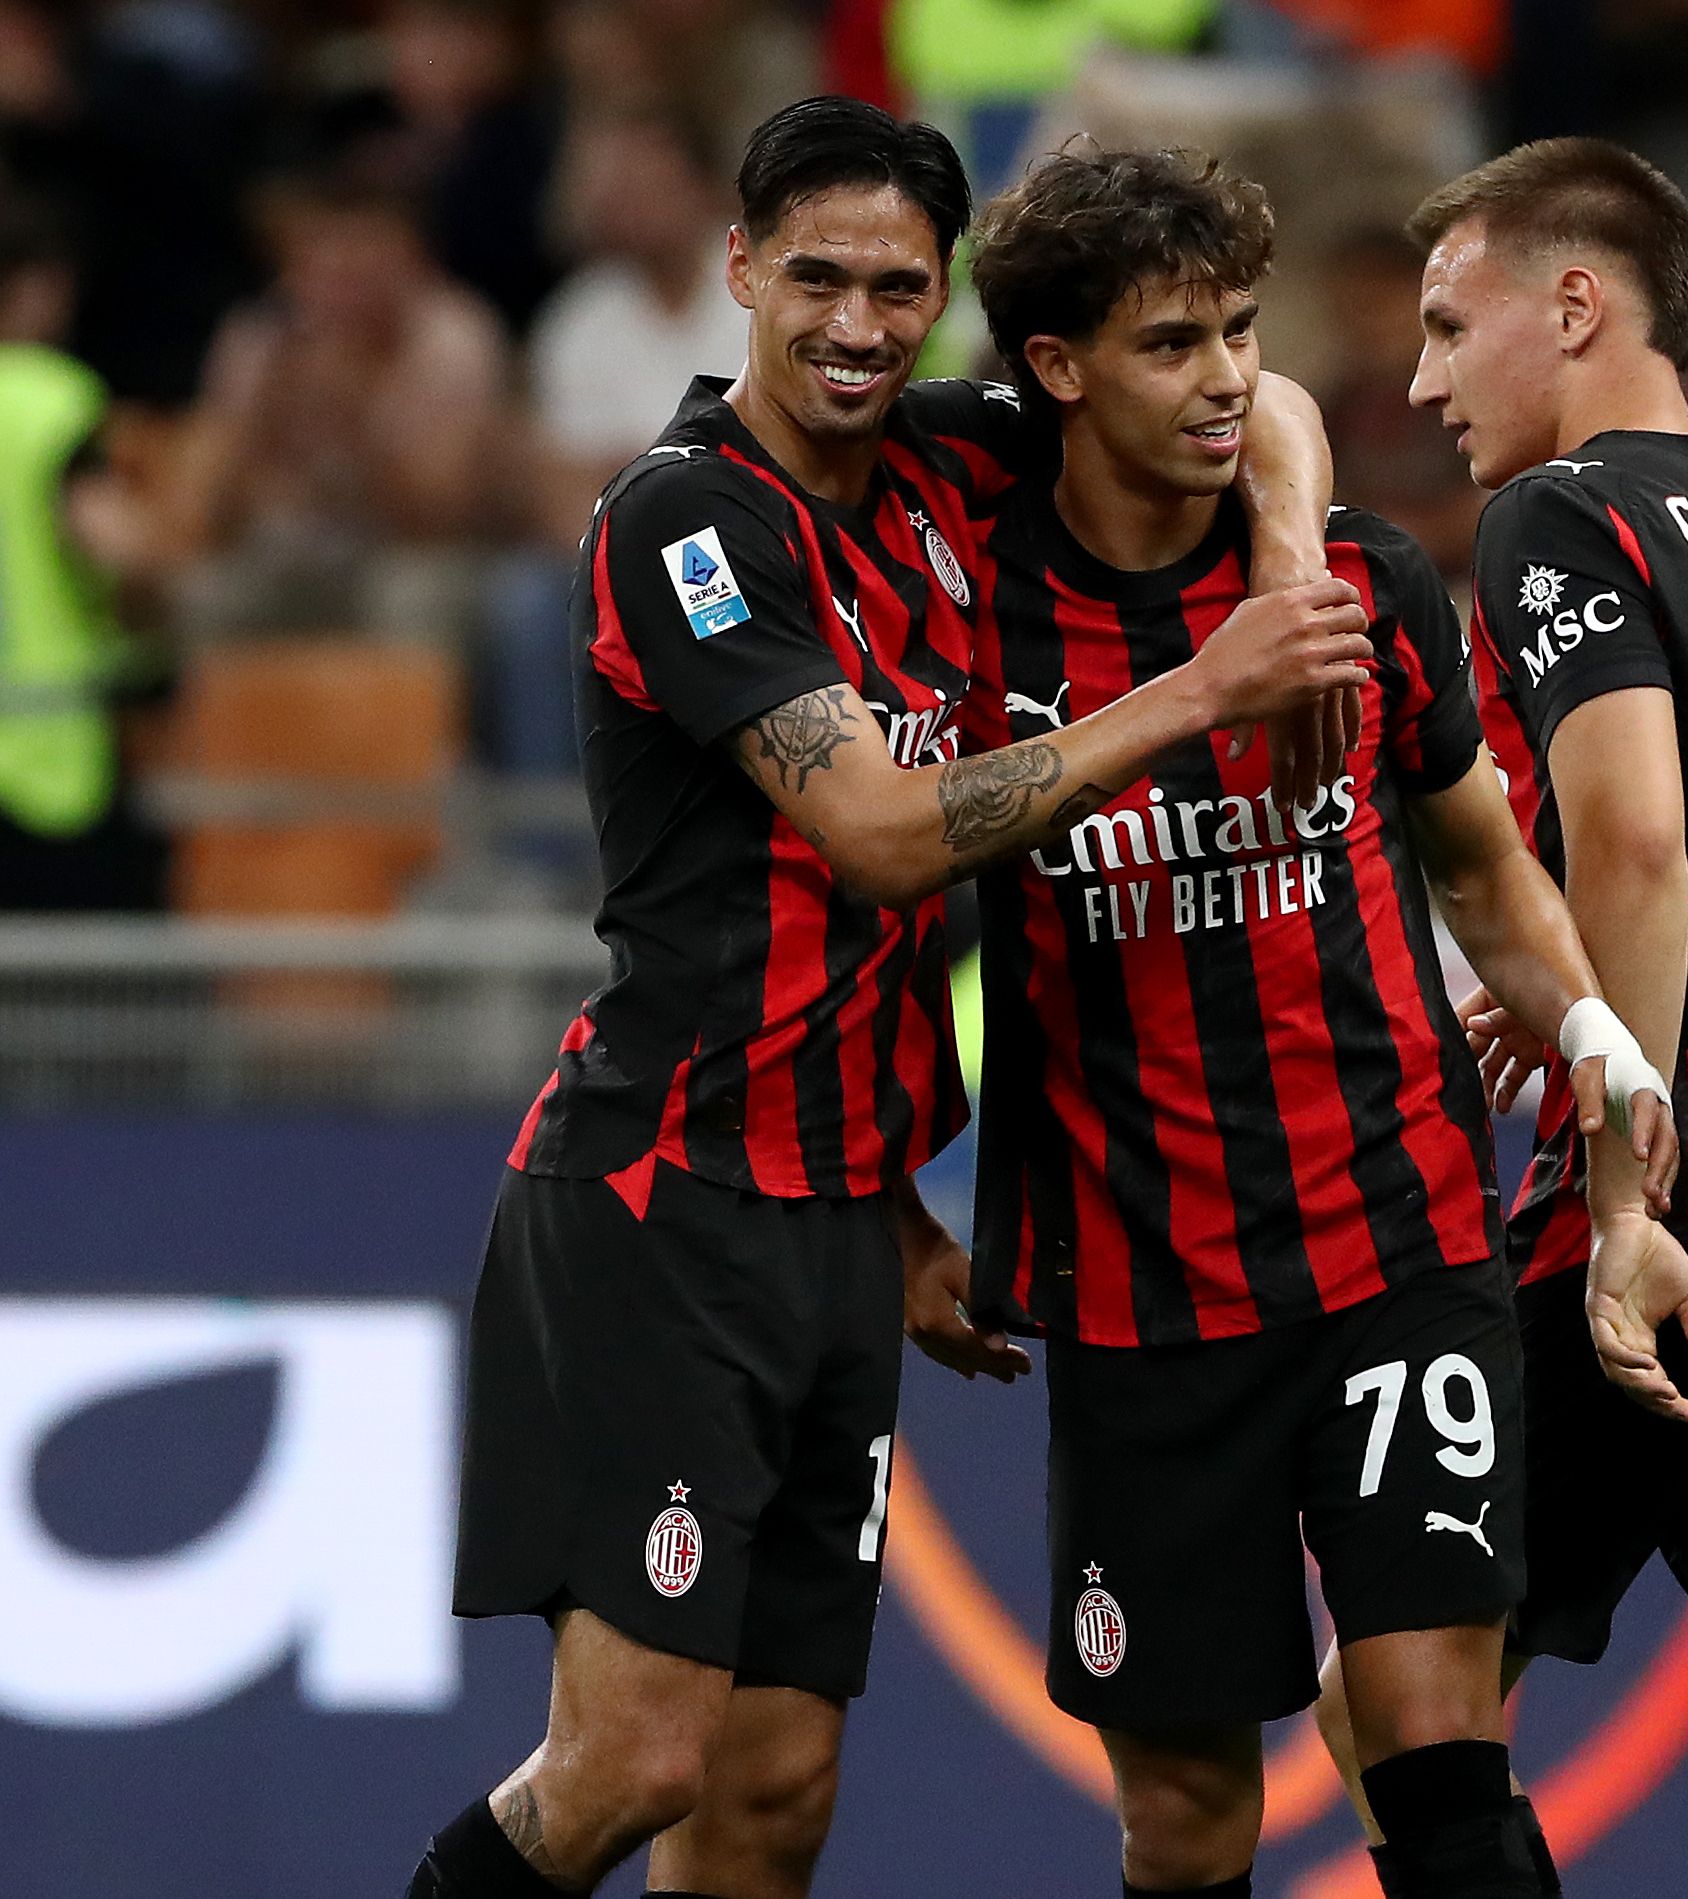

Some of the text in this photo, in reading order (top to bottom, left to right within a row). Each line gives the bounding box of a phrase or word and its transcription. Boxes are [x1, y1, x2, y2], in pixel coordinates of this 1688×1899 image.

[689, 581, 729, 605] SERIE A
[1519, 590, 1625, 689] MSC
[1084, 850, 1326, 943] FLY BETTER
[1345, 1353, 1496, 1498] 79
[660, 1514, 693, 1533] ACM
[659, 1574, 685, 1587] 1899
[1091, 1655, 1115, 1666] 1899
